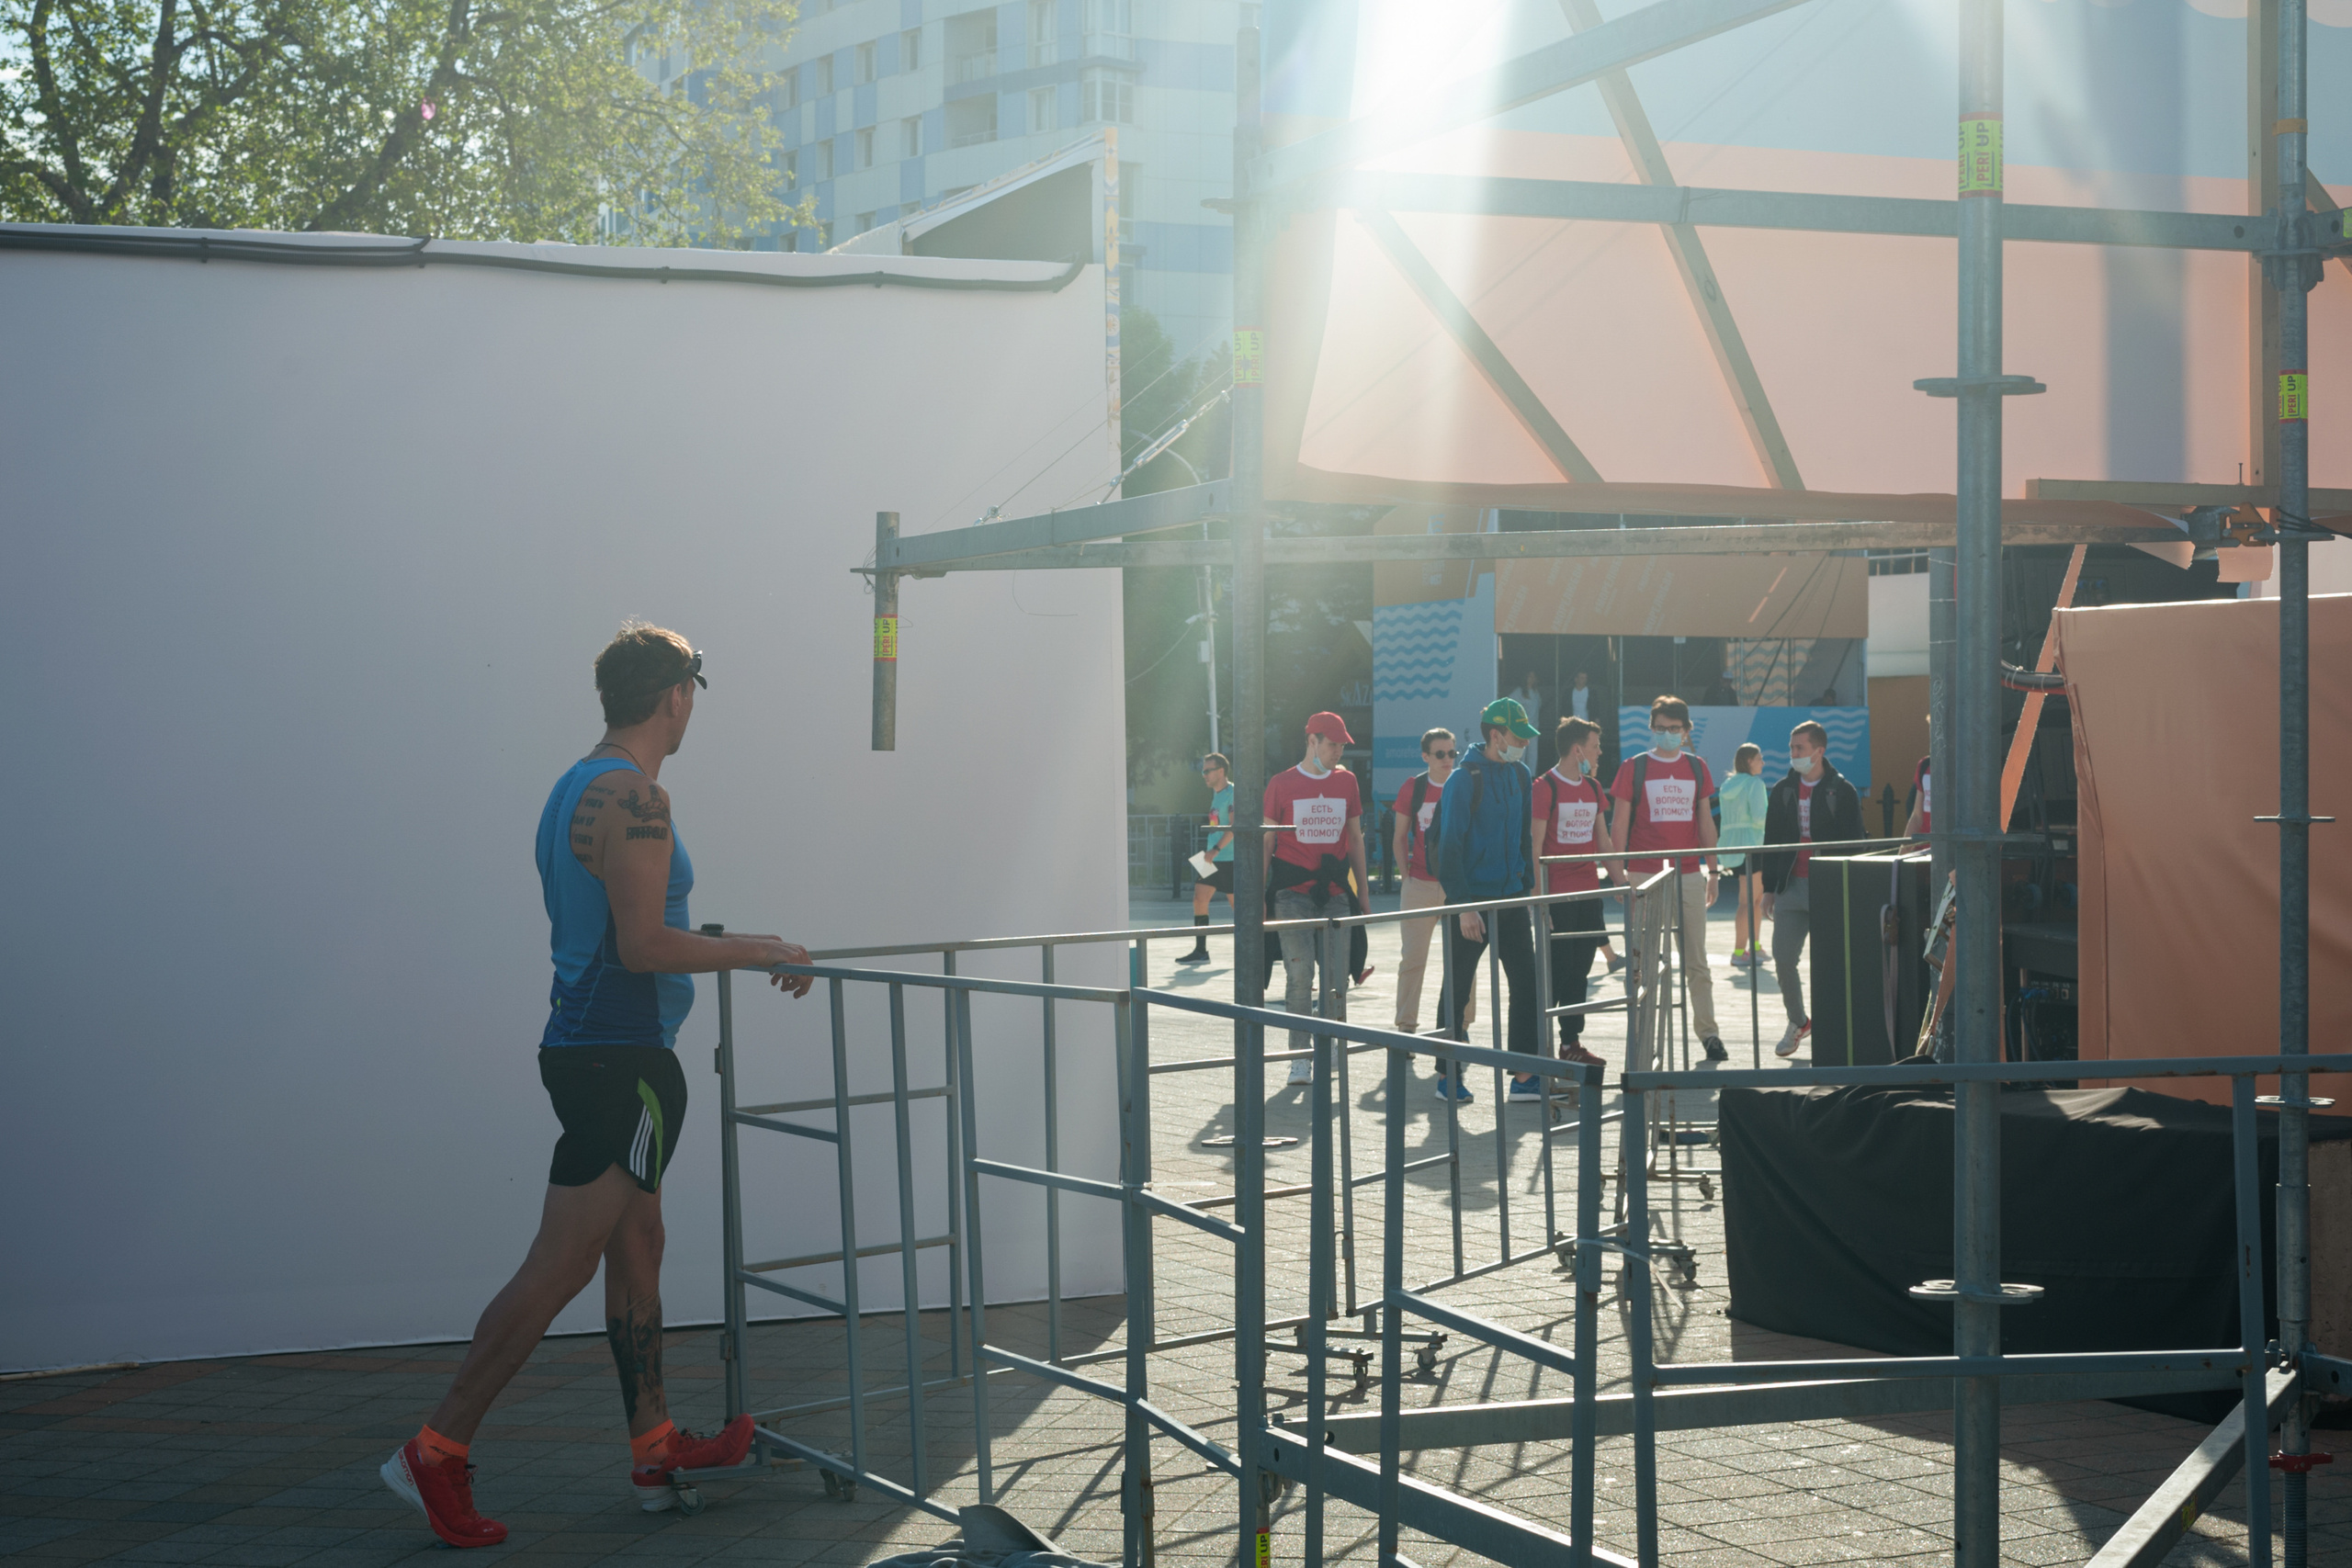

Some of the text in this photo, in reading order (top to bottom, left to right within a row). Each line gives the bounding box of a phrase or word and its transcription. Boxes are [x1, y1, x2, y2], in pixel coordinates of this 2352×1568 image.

[1976, 121, 1990, 182] PERI UP
[1235, 333, 1242, 351] UP
[1250, 333, 1259, 377] PERI UP
[2288, 376, 2296, 413] PERI UP
[883, 619, 890, 633] UP
[1663, 785, 1683, 794] ЕСТЬ
[1656, 796, 1690, 805] ВОПРОС?
[1311, 805, 1333, 813] ЕСТЬ
[1574, 808, 1590, 817] ЕСТЬ
[1302, 817, 1341, 826] ВОПРОС?
[1299, 829, 1305, 837] Я
[1260, 1535, 1268, 1552] UP
